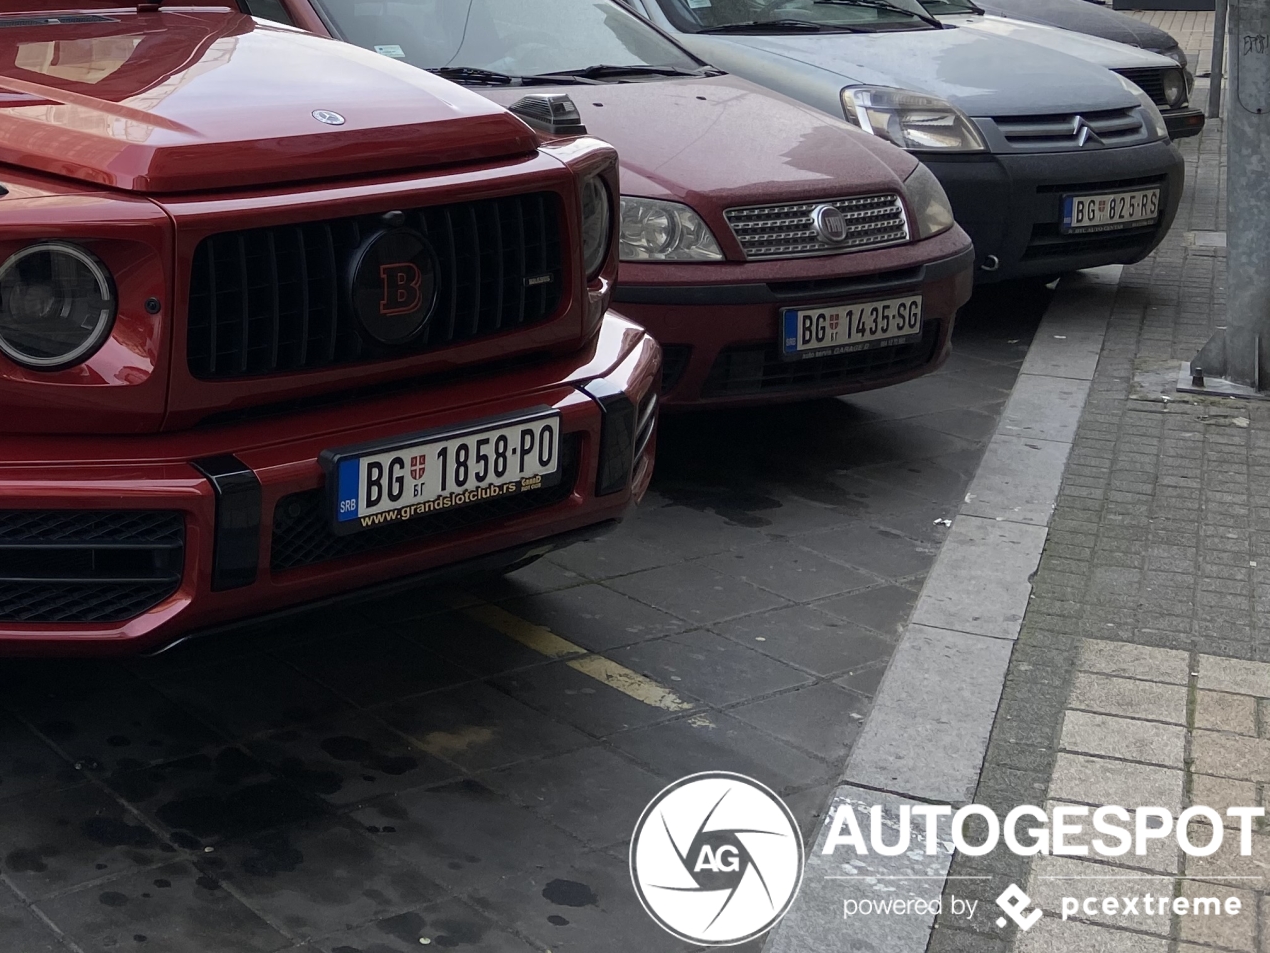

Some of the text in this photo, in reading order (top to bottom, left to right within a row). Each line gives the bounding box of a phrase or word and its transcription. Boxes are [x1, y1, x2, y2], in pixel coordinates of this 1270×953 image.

[1076, 200, 1096, 223] BG
[380, 262, 422, 316] B
[802, 313, 826, 346] BG
[366, 456, 405, 509] BG
[340, 498, 356, 513] SRB
[361, 481, 516, 527] www.grandslotclub.rs
